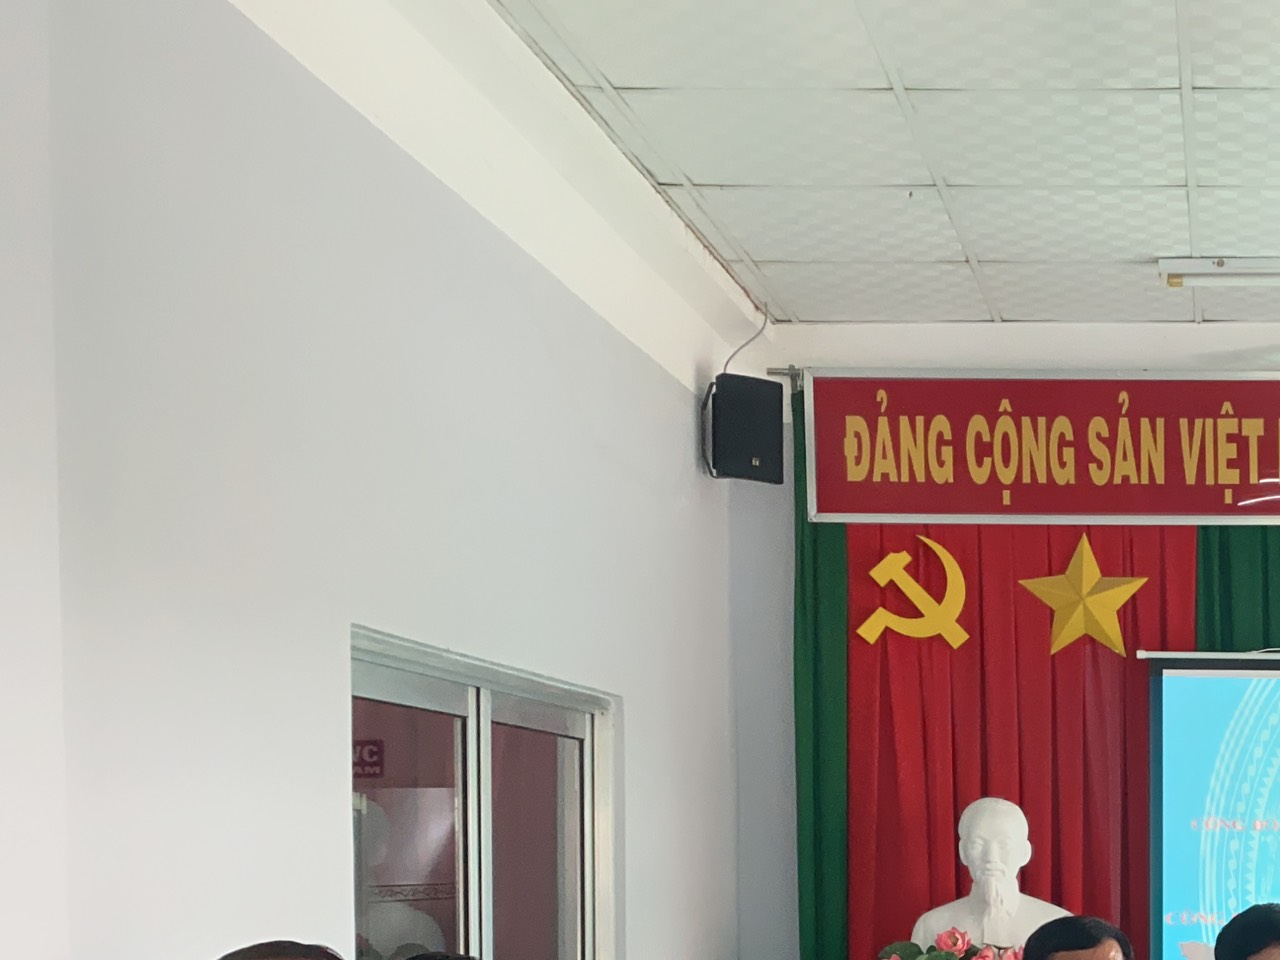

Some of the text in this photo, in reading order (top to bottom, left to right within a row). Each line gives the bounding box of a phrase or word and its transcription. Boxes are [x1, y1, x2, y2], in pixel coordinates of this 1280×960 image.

[844, 389, 954, 484] ĐẢNG
[966, 399, 1075, 506] CỘNG
[1088, 391, 1165, 486] SẢN
[1179, 401, 1264, 504] VIỆT
